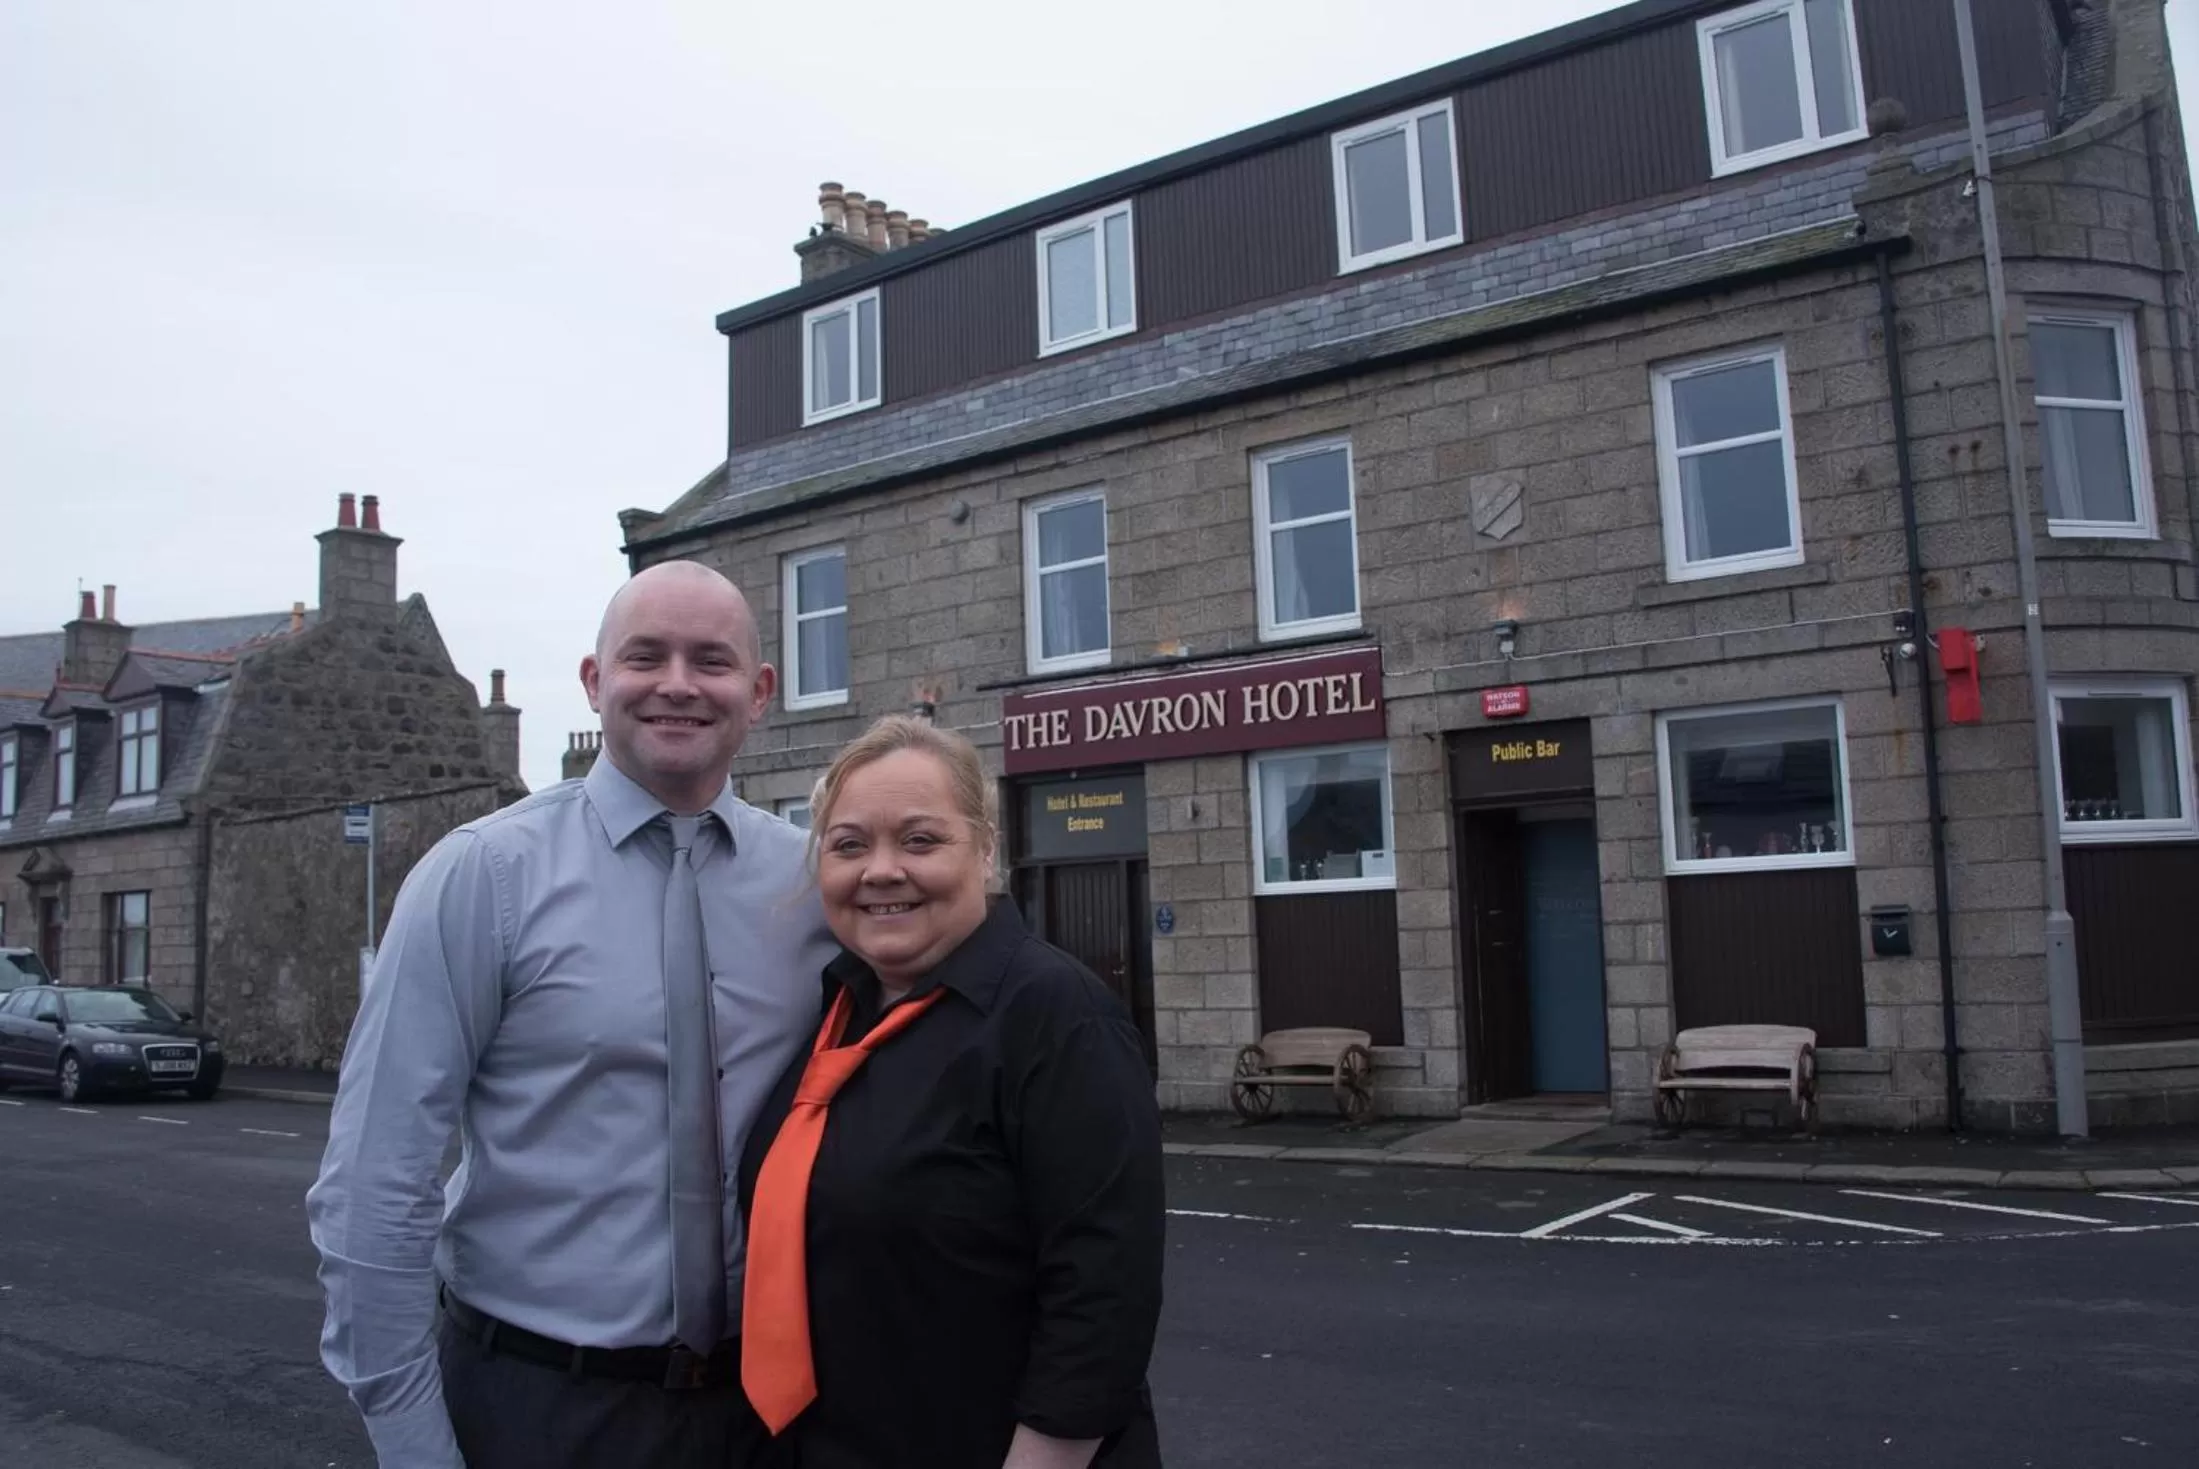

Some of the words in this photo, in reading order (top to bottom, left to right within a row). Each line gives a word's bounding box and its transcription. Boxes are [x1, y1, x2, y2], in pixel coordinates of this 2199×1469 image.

[1004, 709, 1072, 751] THE
[1083, 689, 1227, 743] DAVRON
[1242, 672, 1376, 725] HOTEL
[1491, 742, 1533, 762] Public
[1536, 739, 1560, 758] Bar
[1046, 795, 1069, 811] Hotel
[1070, 793, 1077, 809] &
[1079, 790, 1124, 809] Restaurant
[1067, 816, 1104, 832] Entrance
